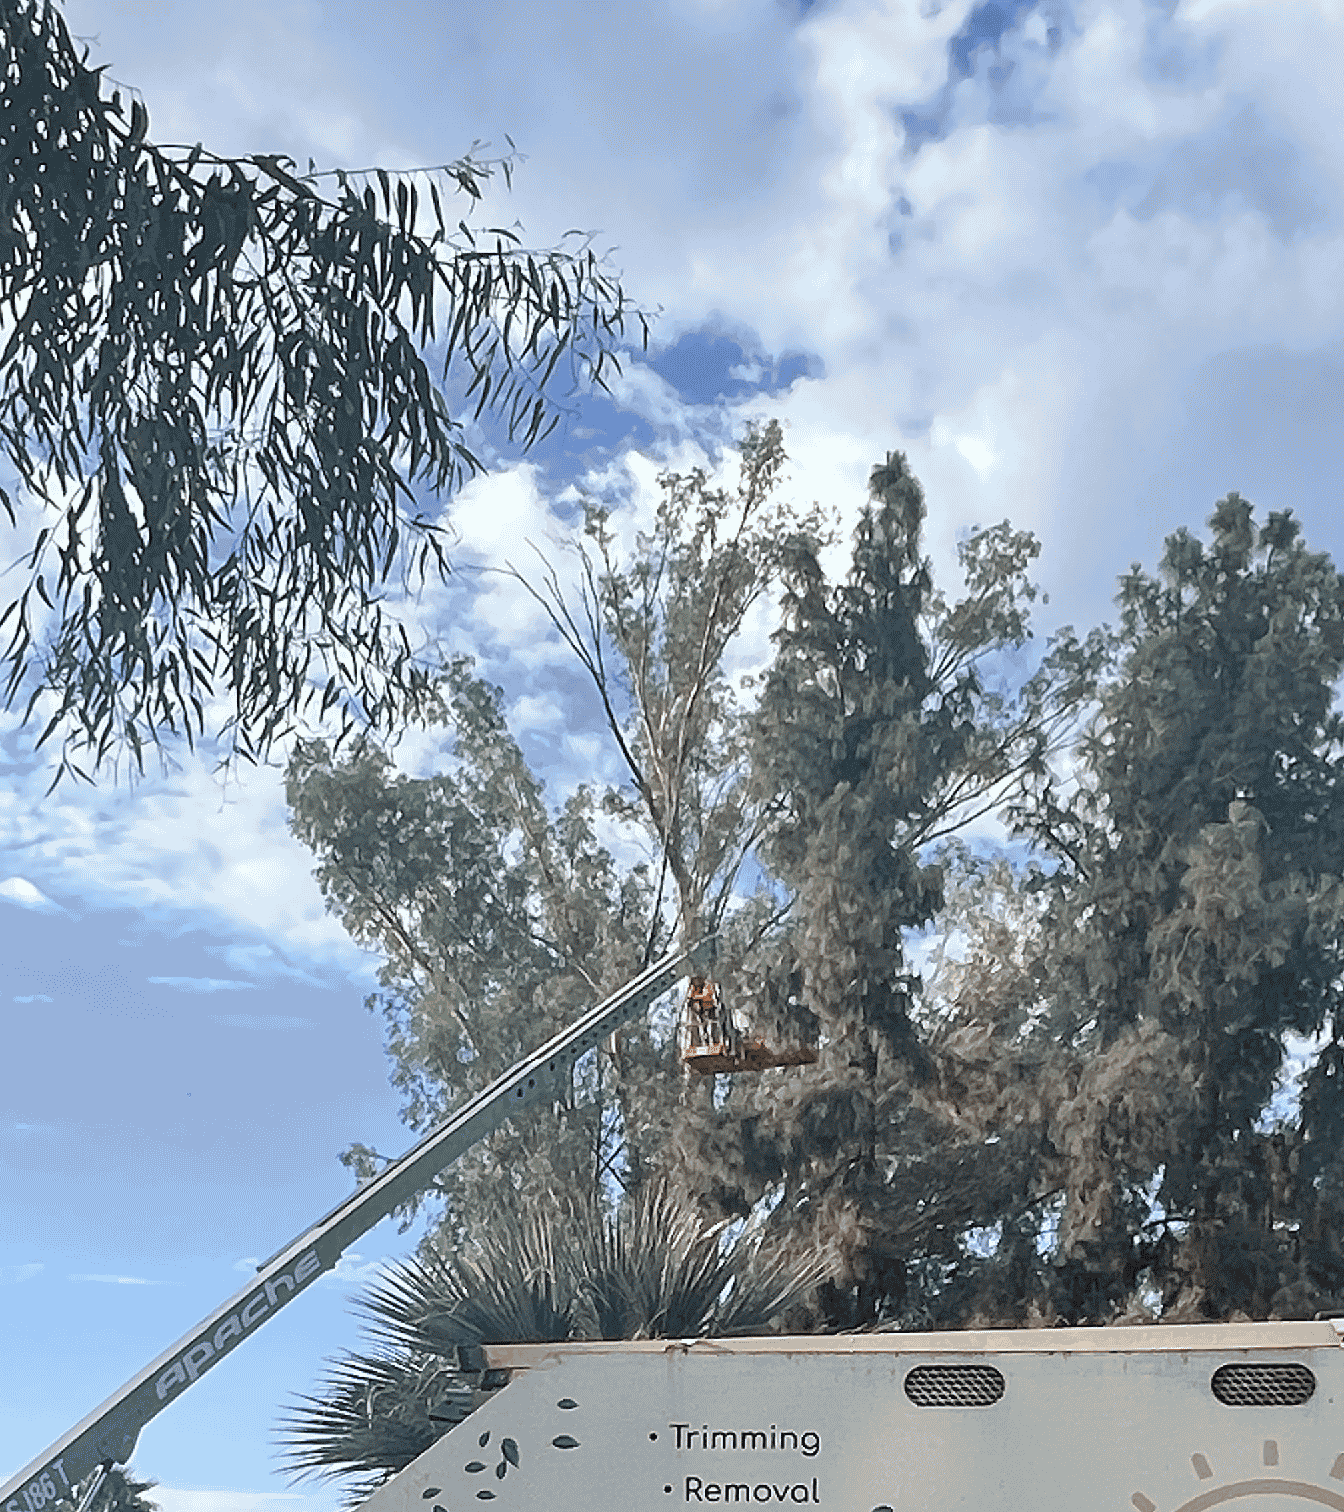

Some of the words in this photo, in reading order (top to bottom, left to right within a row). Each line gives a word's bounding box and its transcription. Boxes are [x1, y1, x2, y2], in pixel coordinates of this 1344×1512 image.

[155, 1249, 322, 1400] APACHE
[668, 1423, 821, 1458] Trimming
[685, 1475, 820, 1504] Removal
